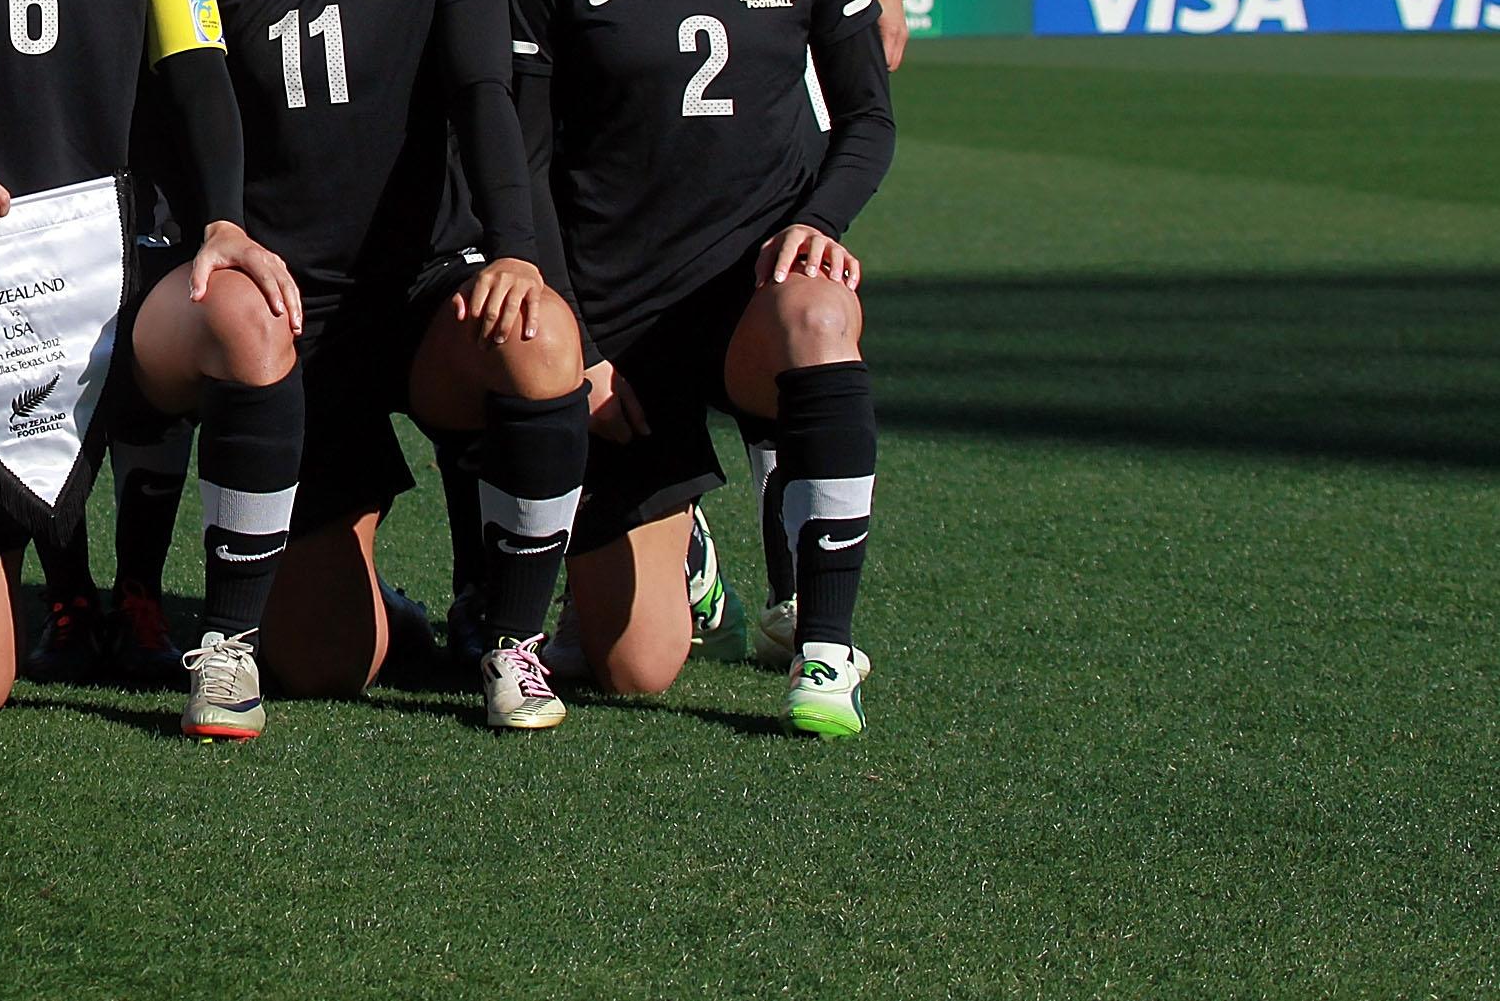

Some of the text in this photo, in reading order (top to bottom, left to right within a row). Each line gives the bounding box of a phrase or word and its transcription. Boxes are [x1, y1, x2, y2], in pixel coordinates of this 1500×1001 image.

[746, 0, 794, 9] FOOTBALL
[268, 4, 349, 109] 11
[678, 14, 734, 117] 2
[10, 309, 21, 317] vs
[3, 321, 35, 341] USA
[41, 338, 61, 350] 2012
[45, 350, 66, 363] USA
[9, 412, 66, 432] NEW ZEALAND
[17, 422, 62, 438] FOOTBALL
